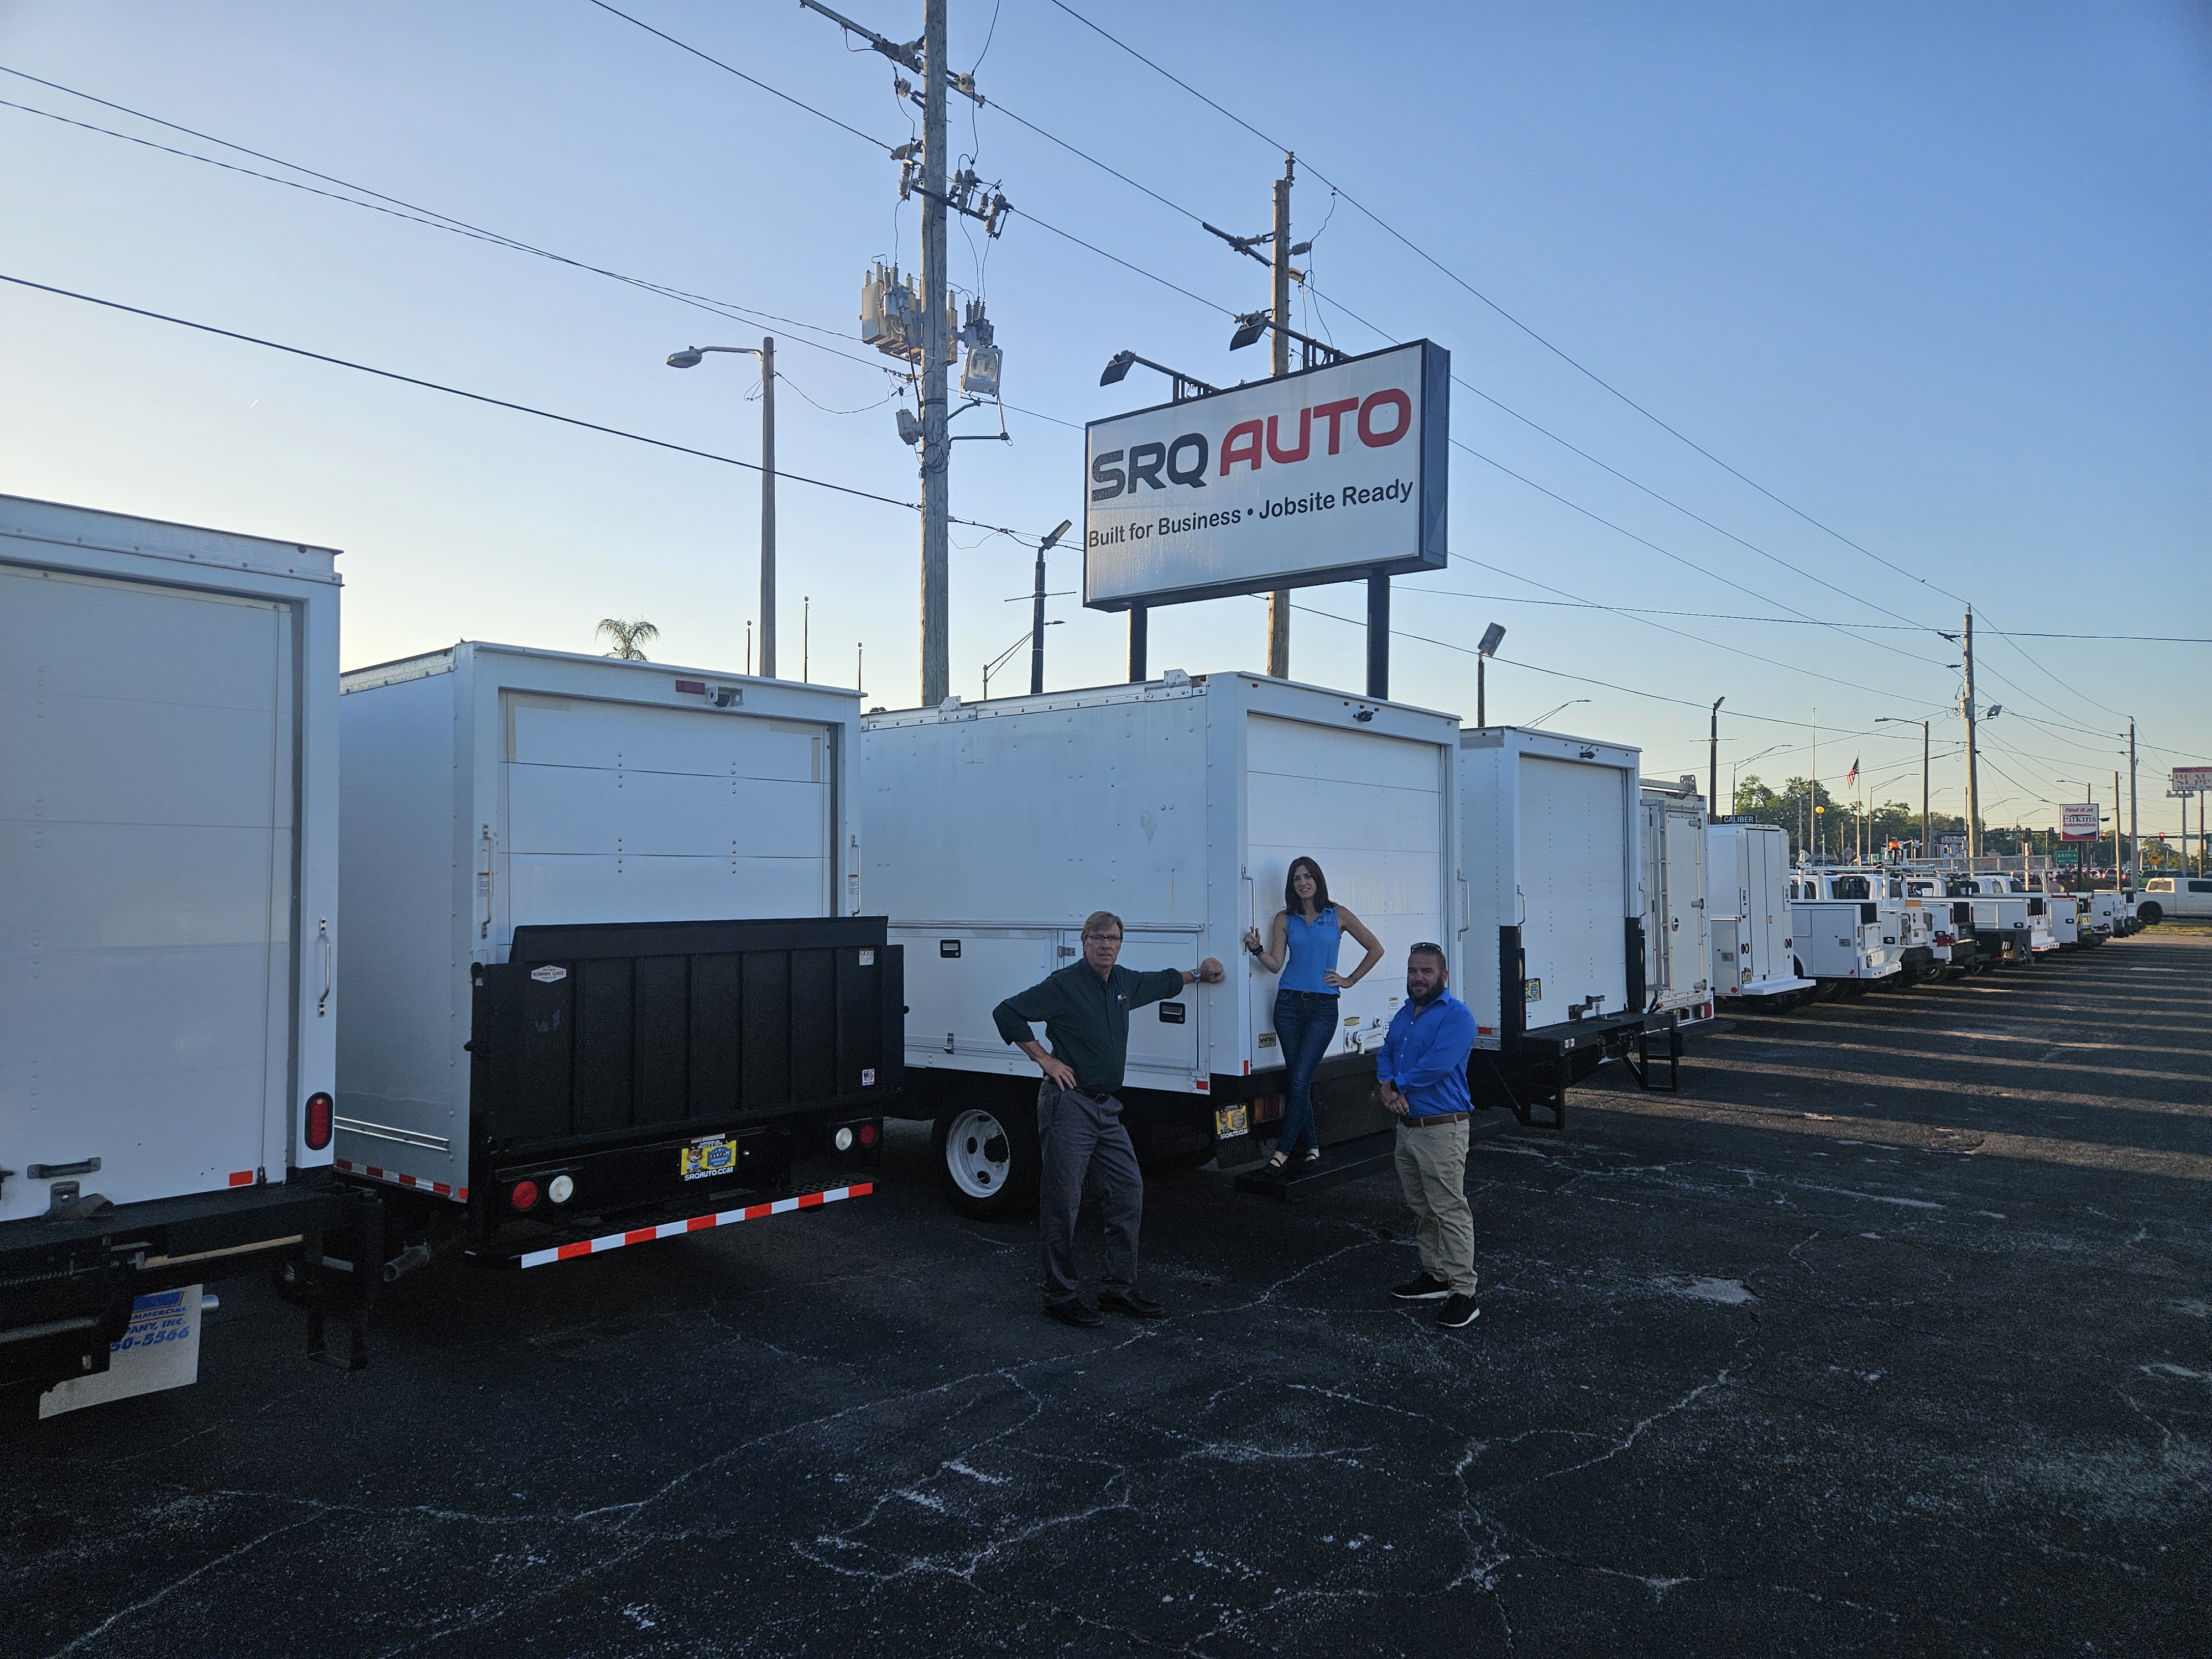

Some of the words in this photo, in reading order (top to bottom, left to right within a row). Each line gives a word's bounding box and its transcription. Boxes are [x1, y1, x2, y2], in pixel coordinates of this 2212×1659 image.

[1092, 432, 1209, 502] SRQ
[1219, 388, 1412, 477] AUTO
[1089, 525, 1125, 547] Built
[1129, 523, 1154, 541] for
[1159, 509, 1241, 536] Business
[1259, 492, 1335, 519] Jobsite
[1343, 478, 1413, 507] Ready
[2063, 815, 2096, 823] Firkins
[1220, 1128, 1248, 1140] SRQAUTO.COM
[684, 1166, 733, 1181] SRQAUTO.COM
